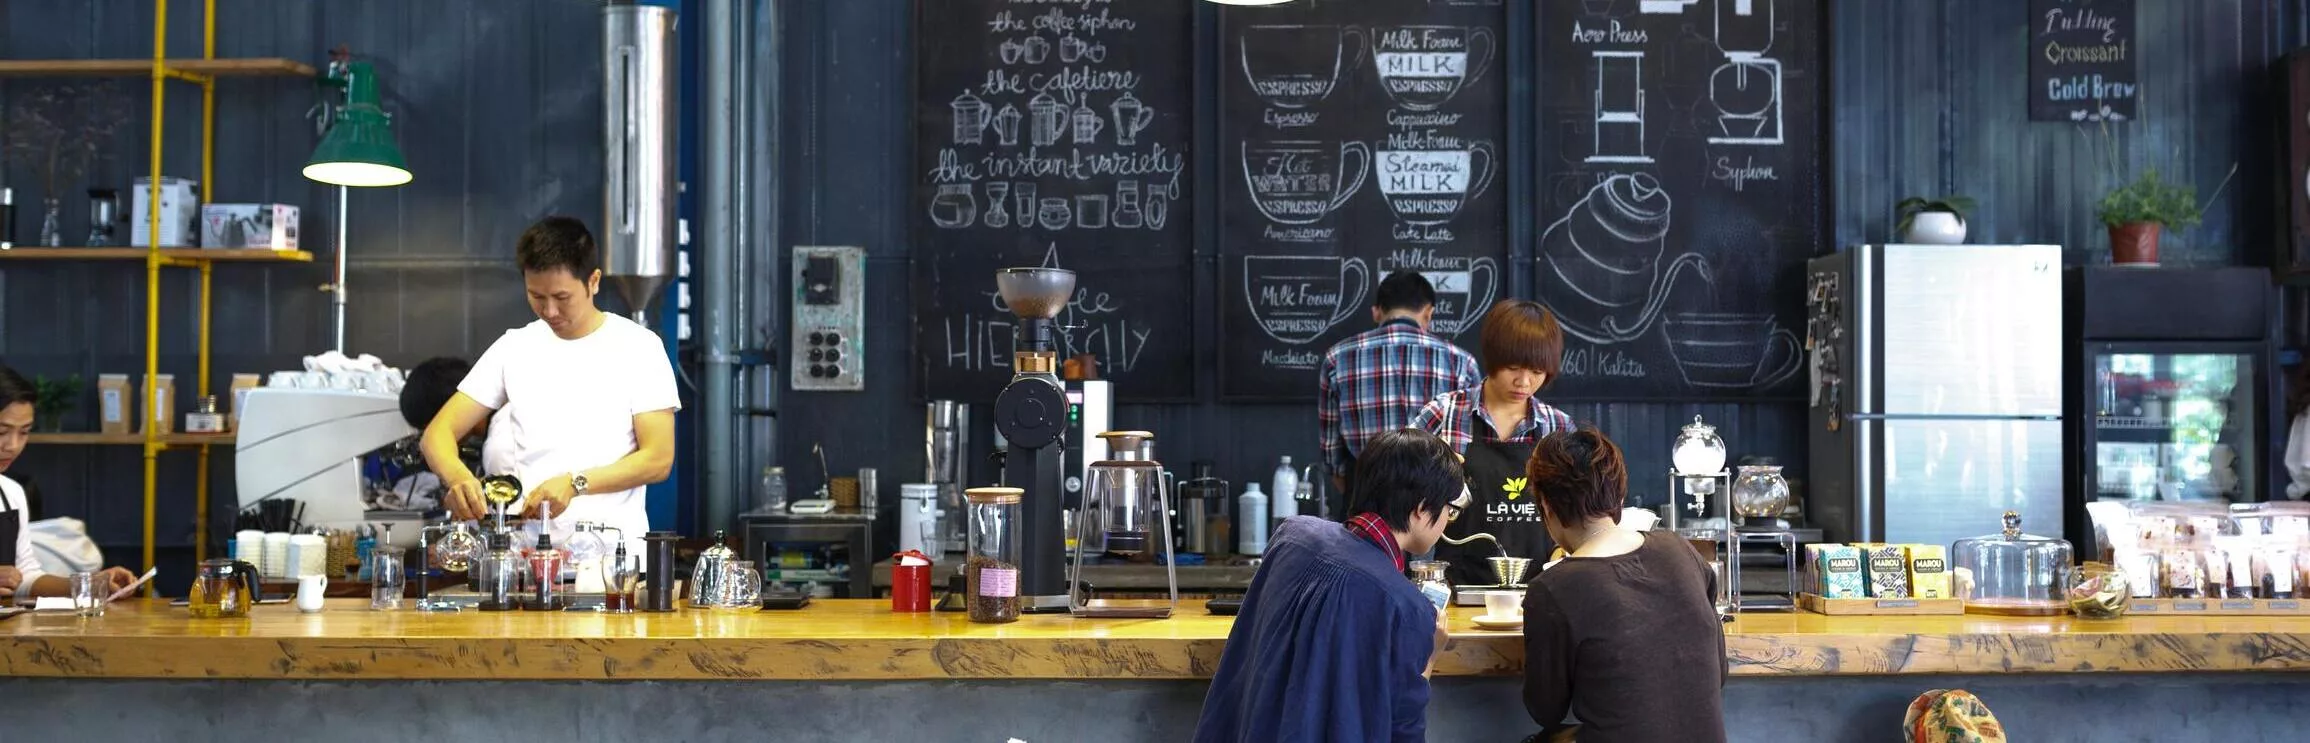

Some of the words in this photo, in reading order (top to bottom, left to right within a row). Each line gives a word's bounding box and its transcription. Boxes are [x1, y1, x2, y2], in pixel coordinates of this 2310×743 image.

[988, 10, 1027, 32] the
[1032, 7, 1075, 34] coffee
[1381, 30, 1419, 49] Milk
[1423, 29, 1464, 49] Foam
[1572, 20, 1606, 43] Aero
[1610, 19, 1648, 43] Press
[2046, 40, 2125, 65] Croissant
[1388, 55, 1454, 73] MILK
[981, 69, 1025, 96] the
[1257, 81, 1328, 96] ESPRESSO
[1389, 79, 1452, 92] ESPRESSO
[2048, 75, 2089, 100] Cold
[2093, 74, 2136, 99] Brew
[1264, 108, 1320, 129] Espresso
[1388, 131, 1425, 150] Milk
[929, 148, 982, 183] the
[982, 146, 1090, 180] instant
[1087, 143, 1184, 200] variety
[1712, 155, 1778, 192] Syphon
[1252, 174, 1331, 192] WATER
[1391, 174, 1453, 191] MILK
[1262, 200, 1327, 214] ESPRESSO
[1394, 199, 1458, 213] ESPRESSO
[1264, 224, 1336, 239] Americano
[1424, 224, 1455, 240] Latte
[1391, 248, 1425, 269] Milk
[1261, 285, 1297, 306] Milk
[1299, 283, 1338, 306] Foam
[1265, 319, 1326, 332] ESPRESSO
[1830, 559, 1856, 567] MAROU
[1874, 559, 1899, 567] MAROU
[1916, 559, 1941, 568] MAROU
